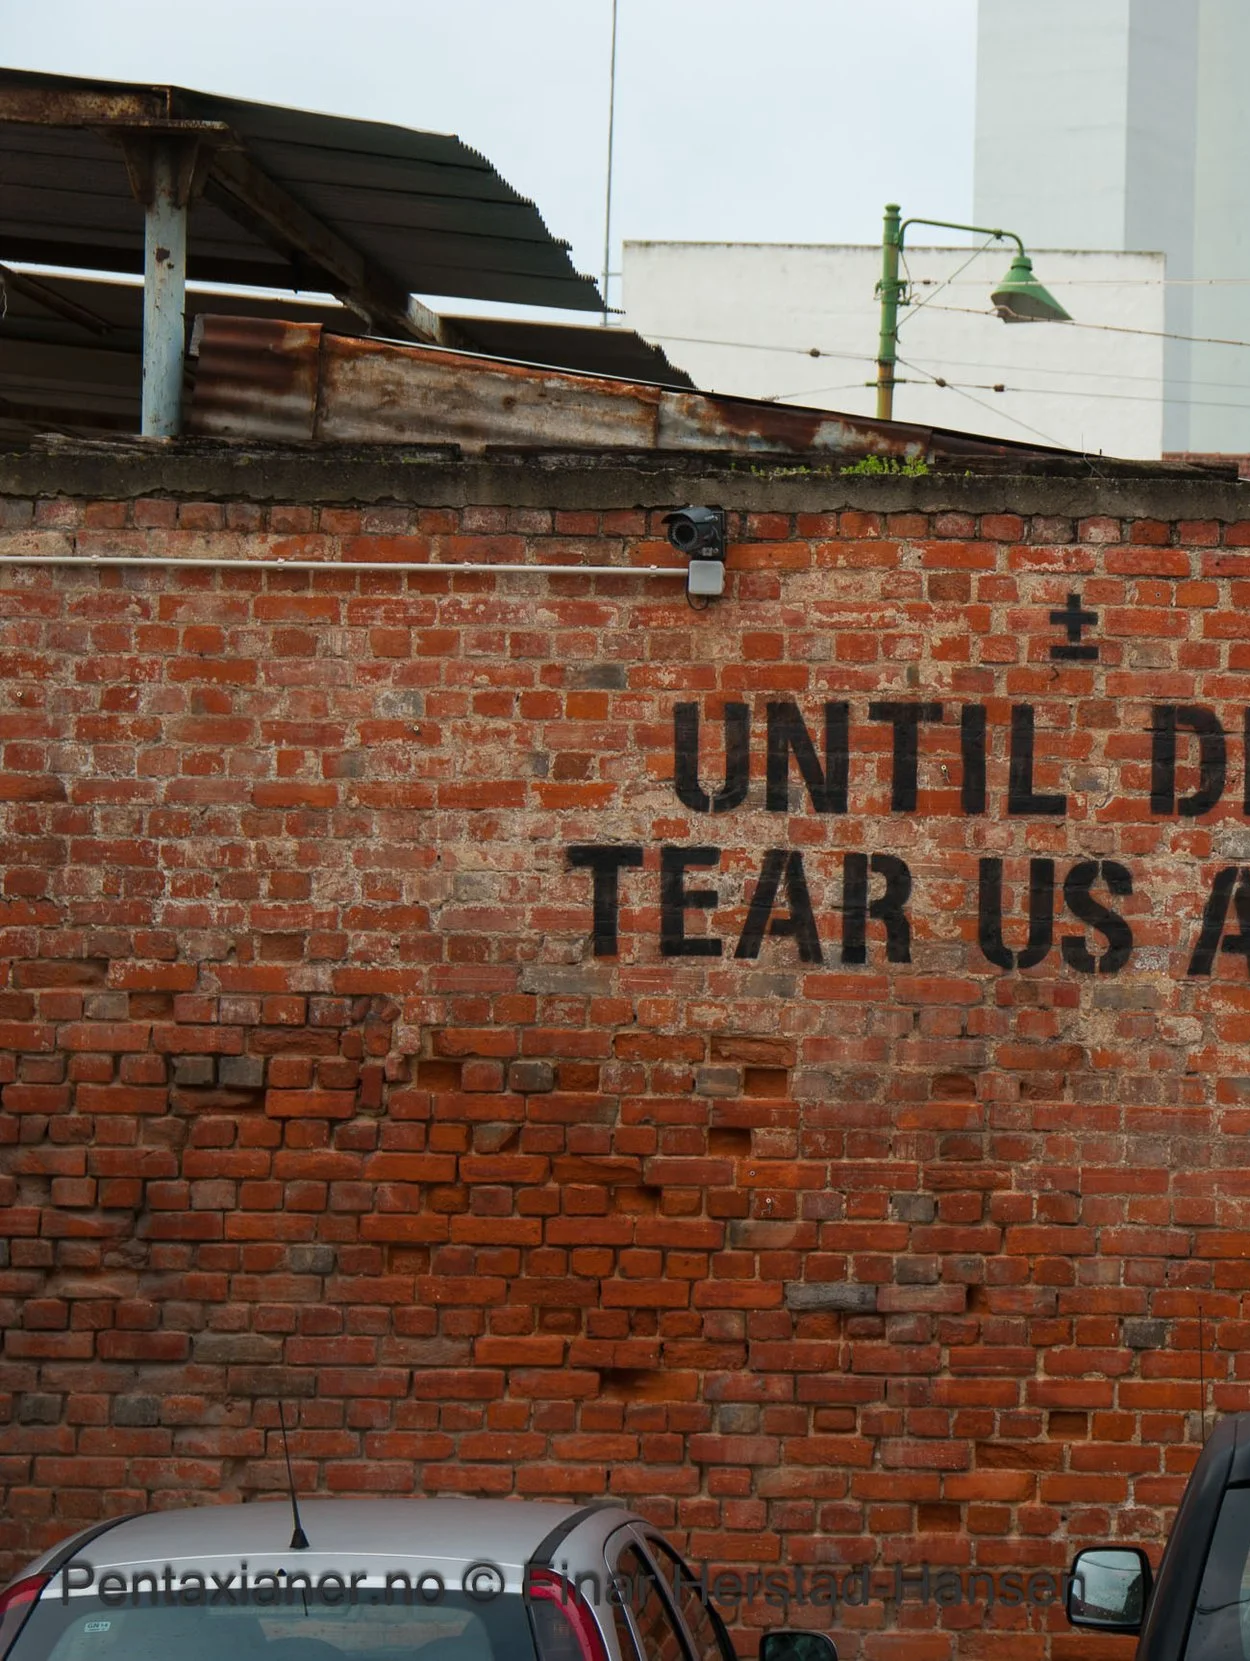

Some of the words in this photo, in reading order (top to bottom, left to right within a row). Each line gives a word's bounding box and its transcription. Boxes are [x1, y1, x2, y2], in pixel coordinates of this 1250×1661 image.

[674, 701, 1067, 815] UNTIL
[566, 845, 914, 964] TEAR
[977, 857, 1134, 974] US
